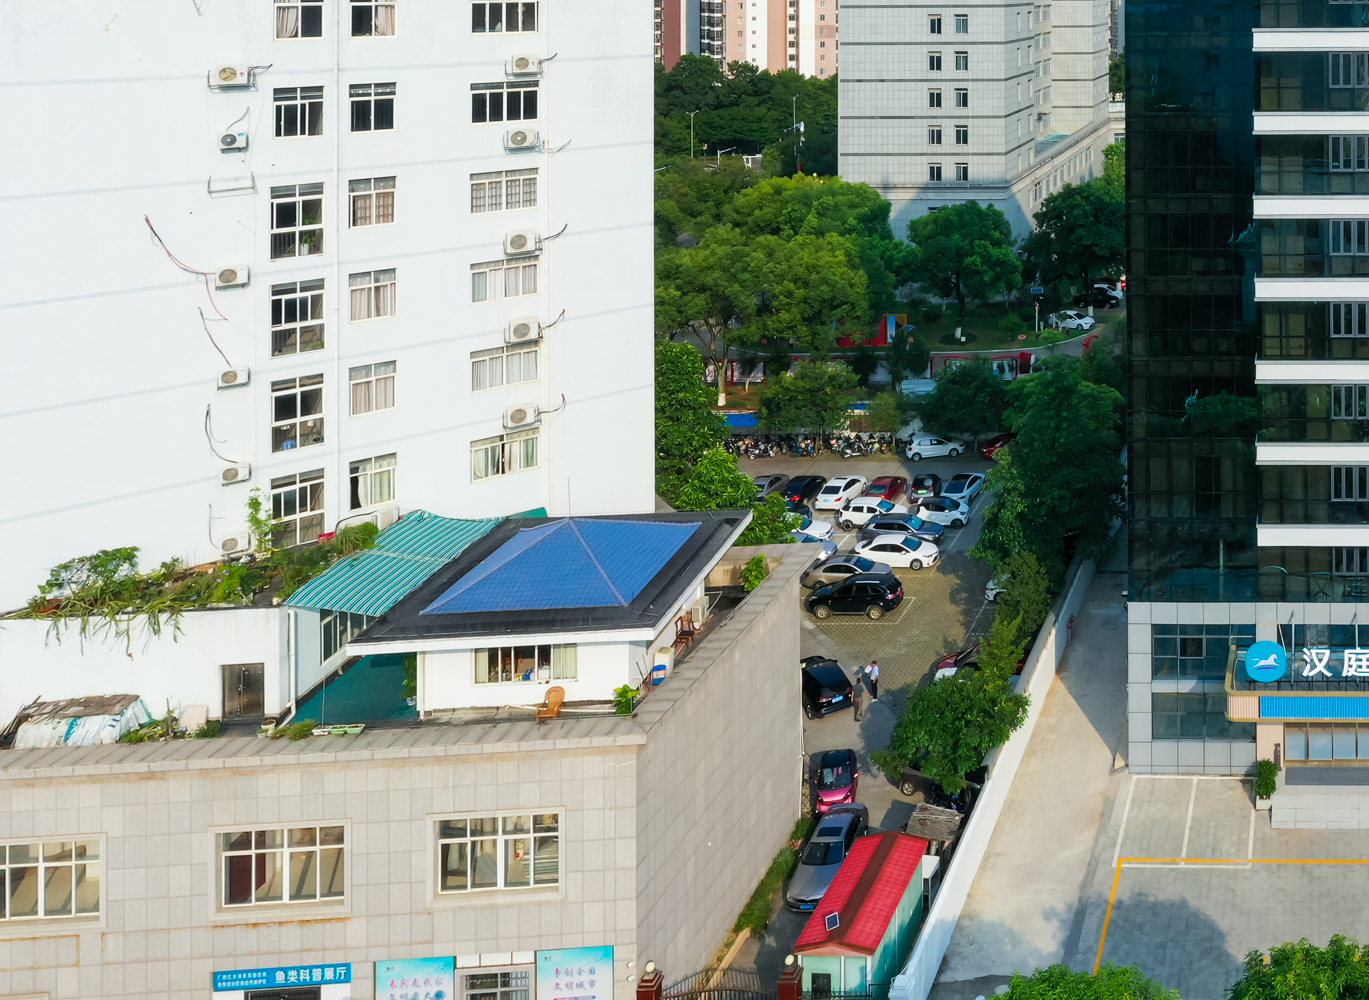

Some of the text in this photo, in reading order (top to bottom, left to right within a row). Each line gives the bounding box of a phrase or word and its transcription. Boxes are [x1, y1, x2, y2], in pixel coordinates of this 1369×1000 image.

[274, 966, 347, 984] 鱼类科普展厅
